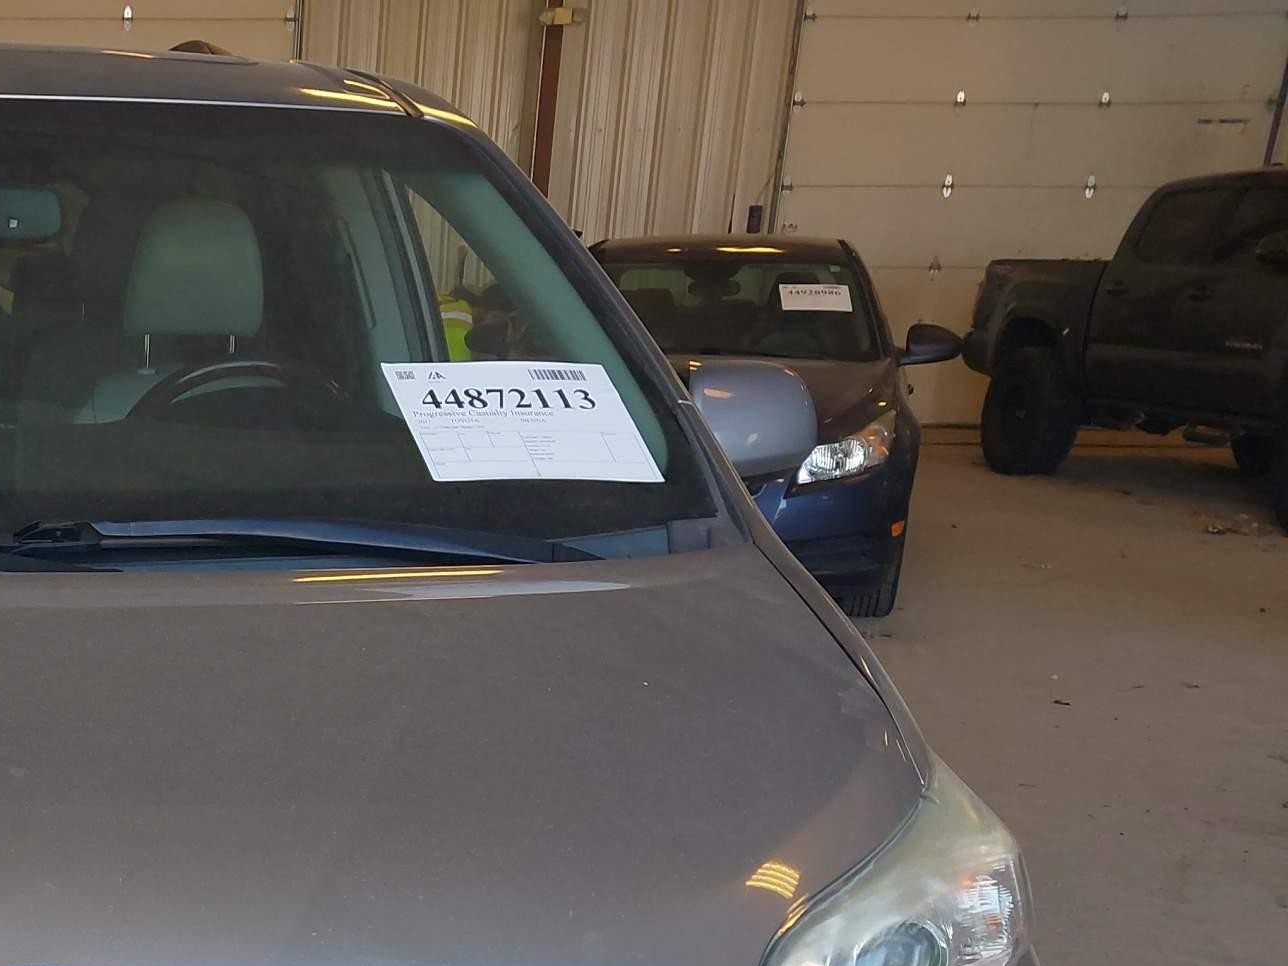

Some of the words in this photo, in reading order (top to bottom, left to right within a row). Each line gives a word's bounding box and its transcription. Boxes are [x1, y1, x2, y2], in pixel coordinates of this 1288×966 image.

[421, 388, 597, 410] 44872113
[412, 410, 466, 419] Progressive
[468, 409, 508, 418] Casualty
[510, 409, 554, 417] Insurance
